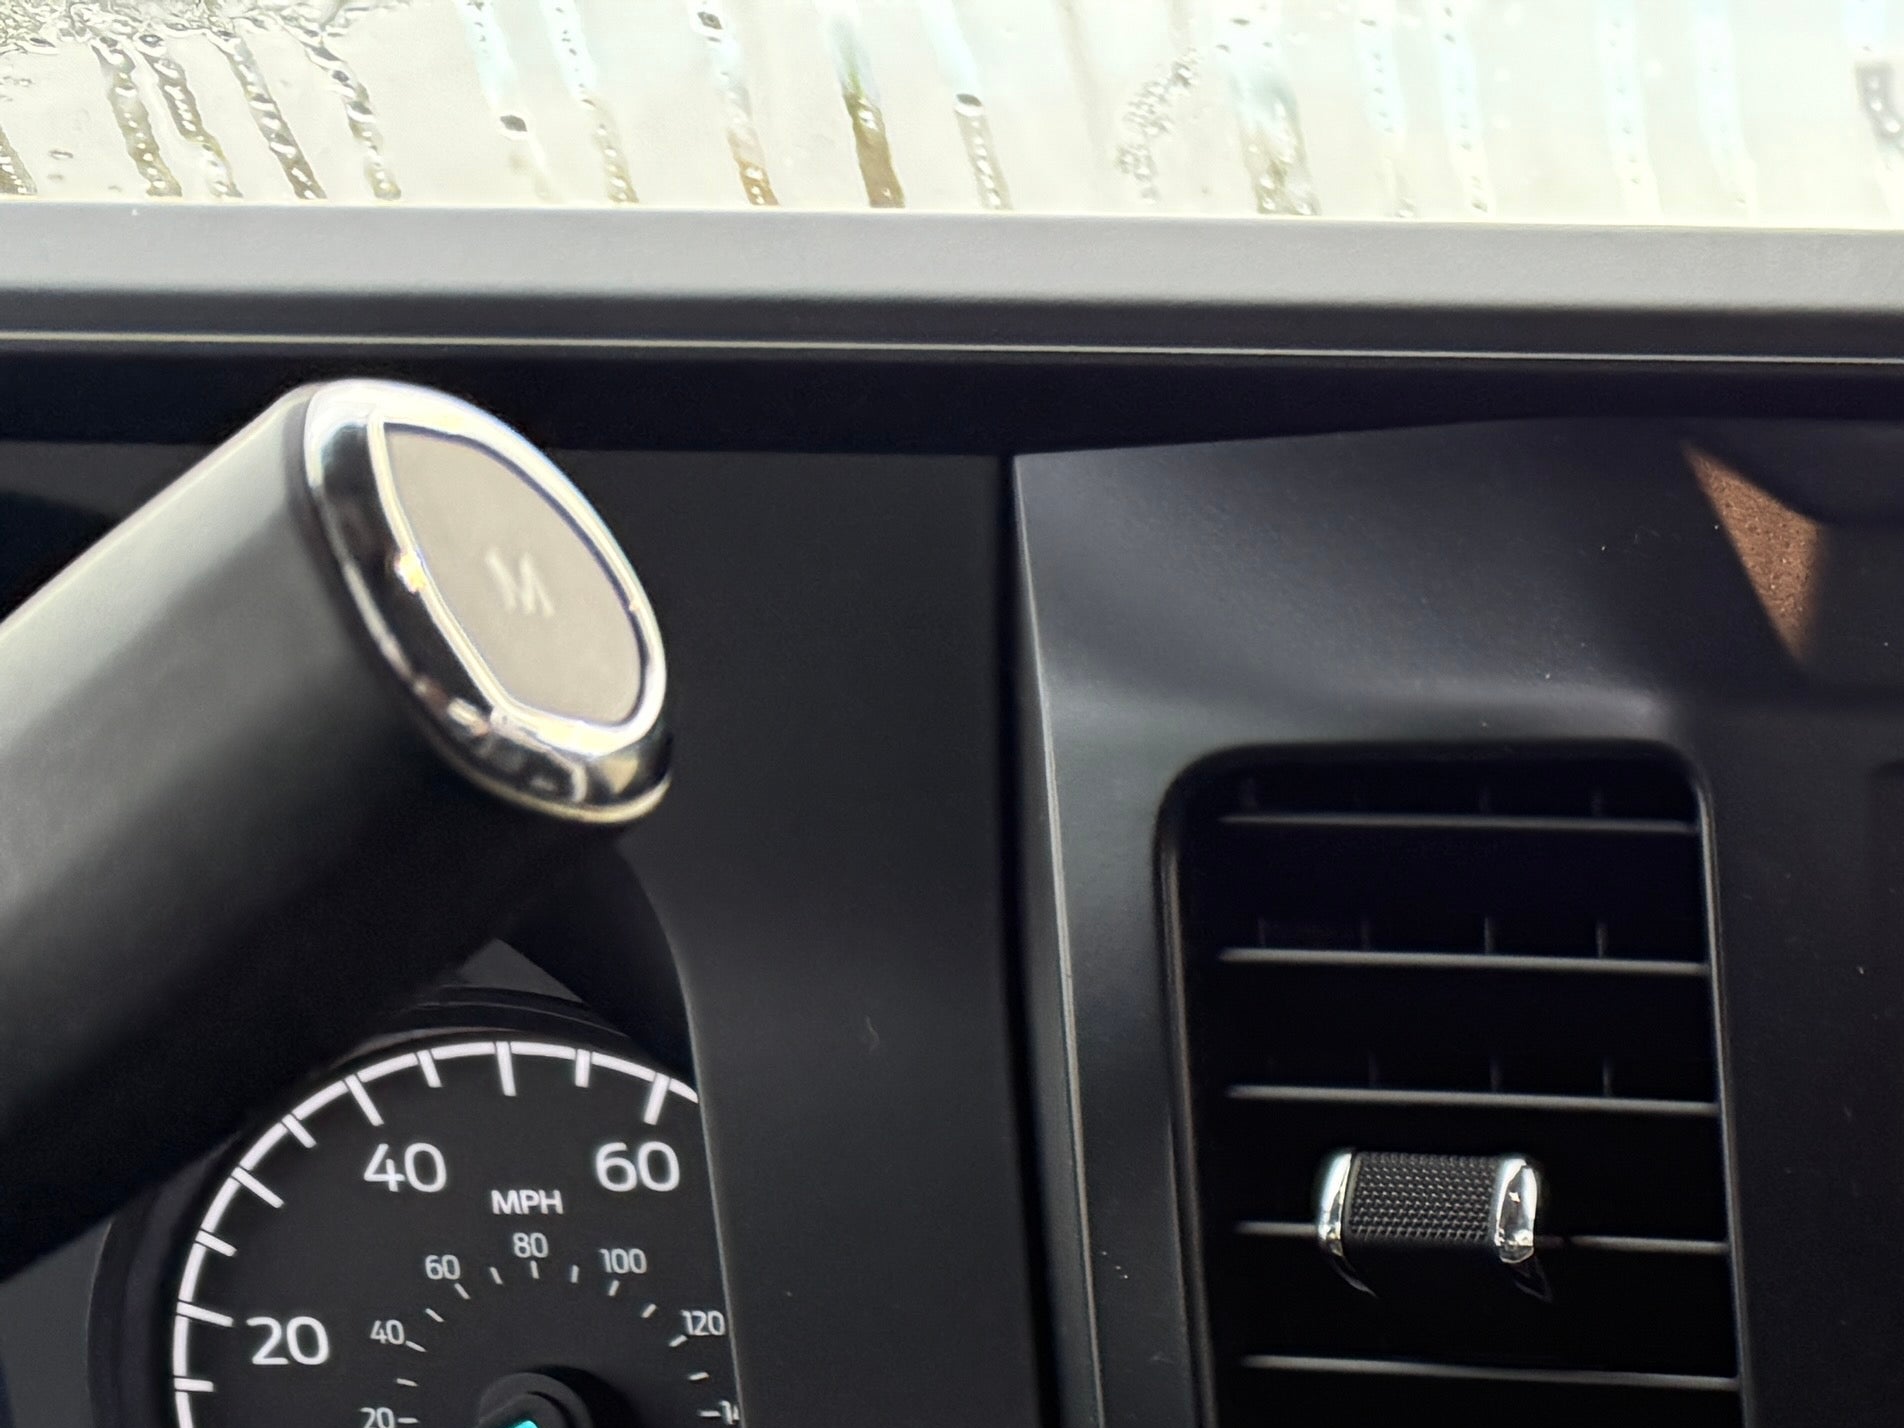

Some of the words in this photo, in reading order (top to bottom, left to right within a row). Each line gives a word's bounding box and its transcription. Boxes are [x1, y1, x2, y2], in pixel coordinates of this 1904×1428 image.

[364, 1143, 446, 1192] 40
[595, 1141, 679, 1191] 60
[491, 1190, 563, 1214] MPH
[513, 1233, 548, 1258] 80
[425, 1255, 460, 1279] 60
[600, 1248, 647, 1273] 100
[370, 1320, 404, 1344] 40
[683, 1310, 725, 1336] 120
[247, 1316, 329, 1365] 20
